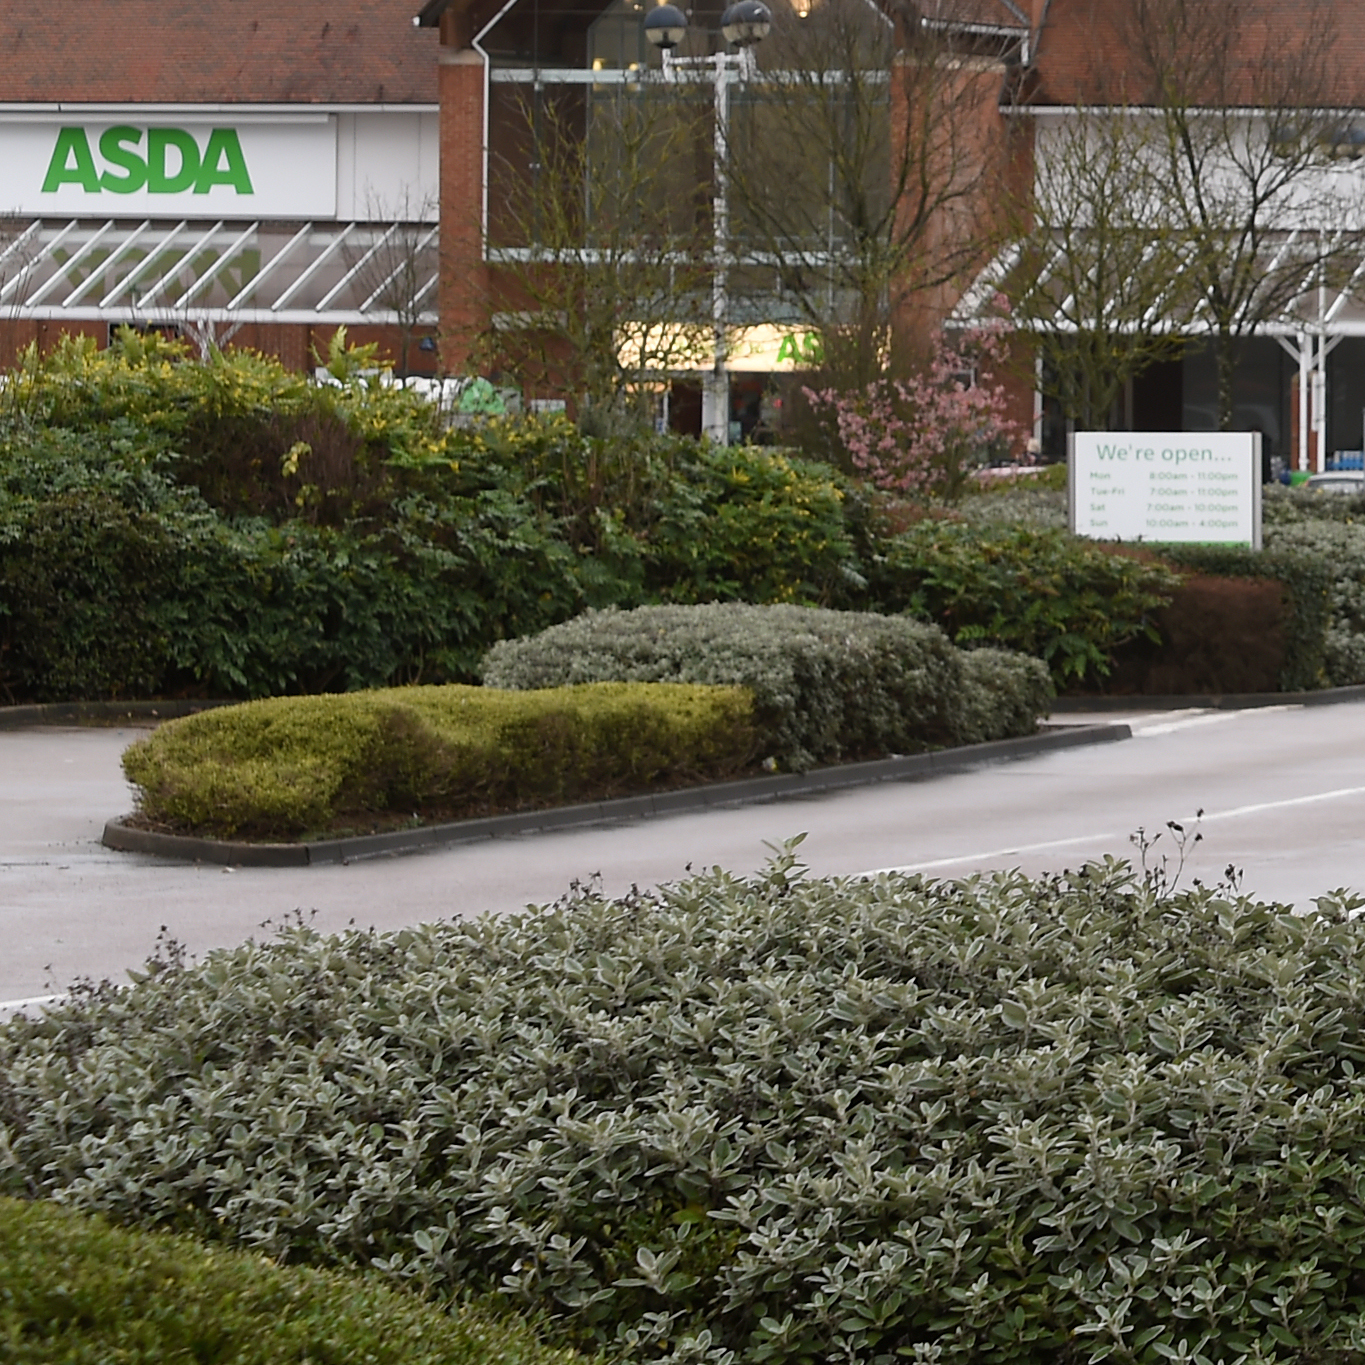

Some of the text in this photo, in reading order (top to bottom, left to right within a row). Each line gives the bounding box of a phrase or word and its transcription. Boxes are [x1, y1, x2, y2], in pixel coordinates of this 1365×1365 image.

[41, 126, 254, 194] ASDA
[1096, 444, 1155, 461] We're
[1090, 472, 1111, 480] Mon
[1090, 503, 1106, 511] Sat
